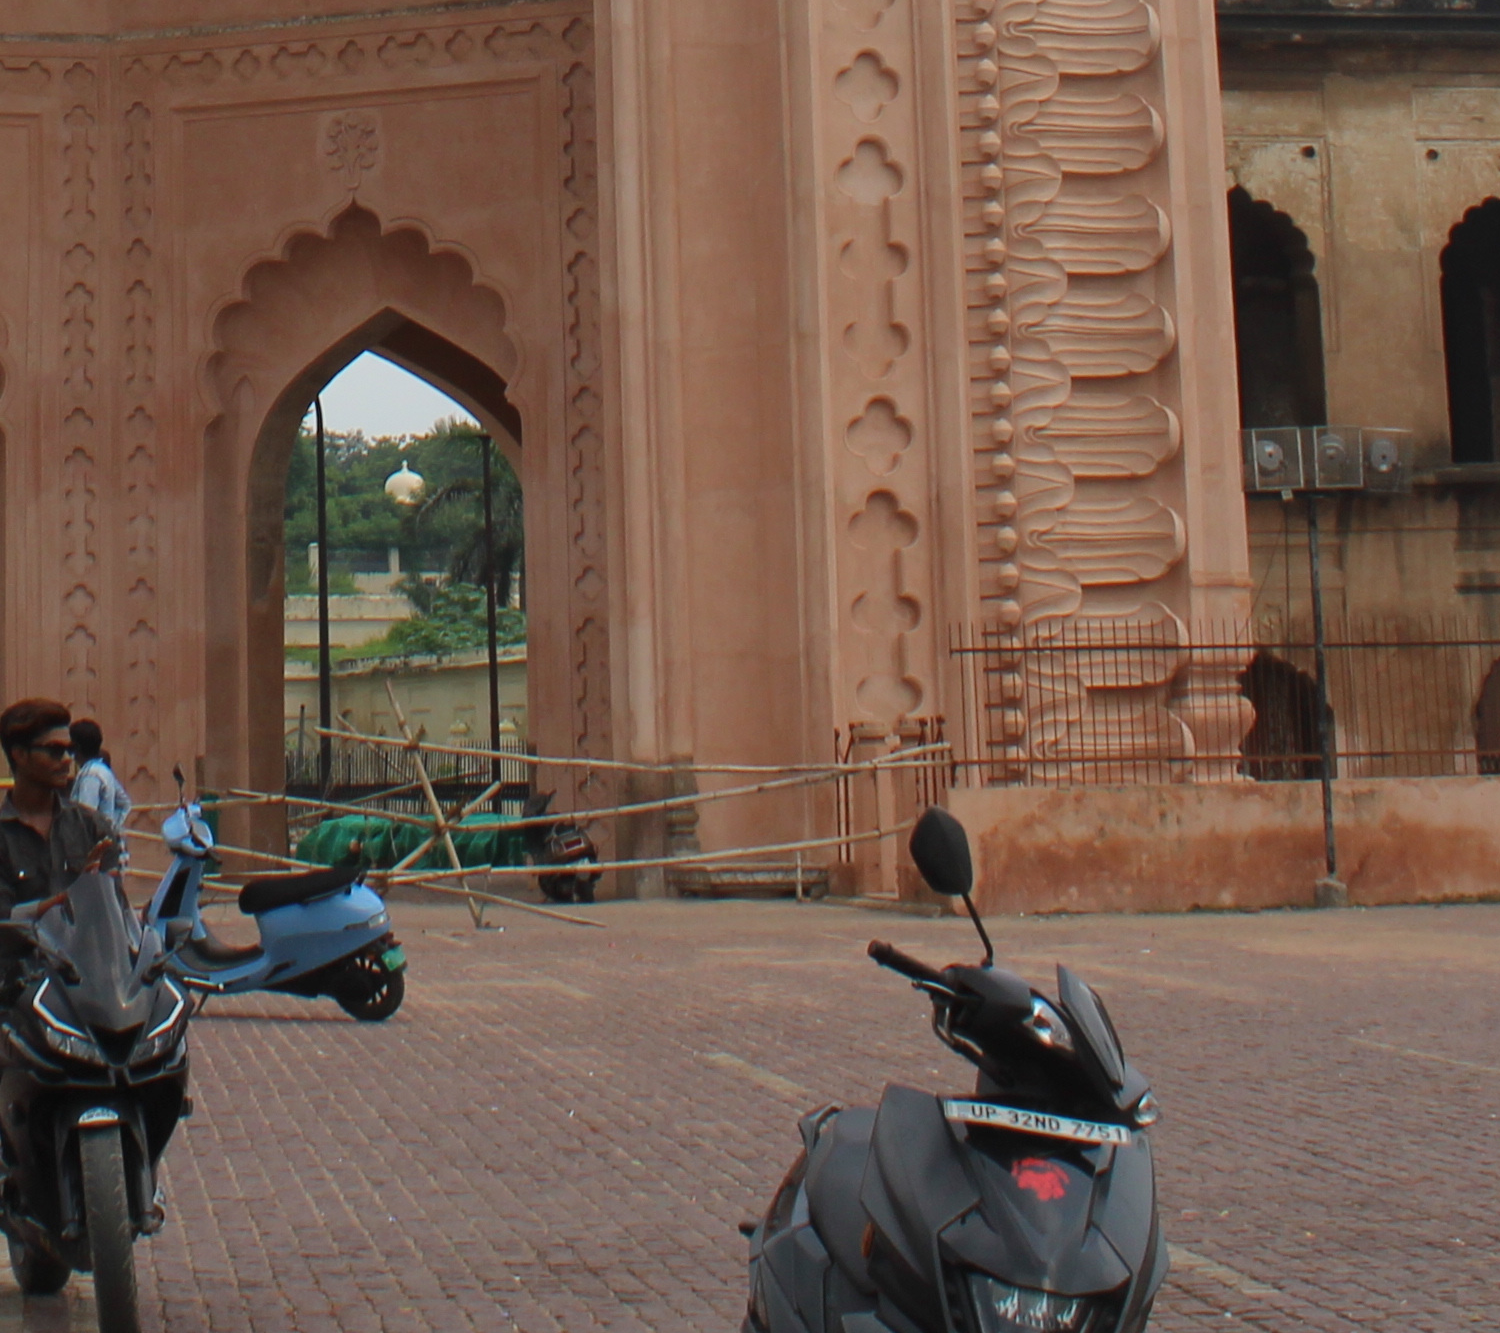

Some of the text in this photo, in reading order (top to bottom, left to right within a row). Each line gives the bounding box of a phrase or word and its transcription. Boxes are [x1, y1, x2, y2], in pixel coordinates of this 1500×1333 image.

[971, 1105, 1124, 1142] UP 32ND 7751
